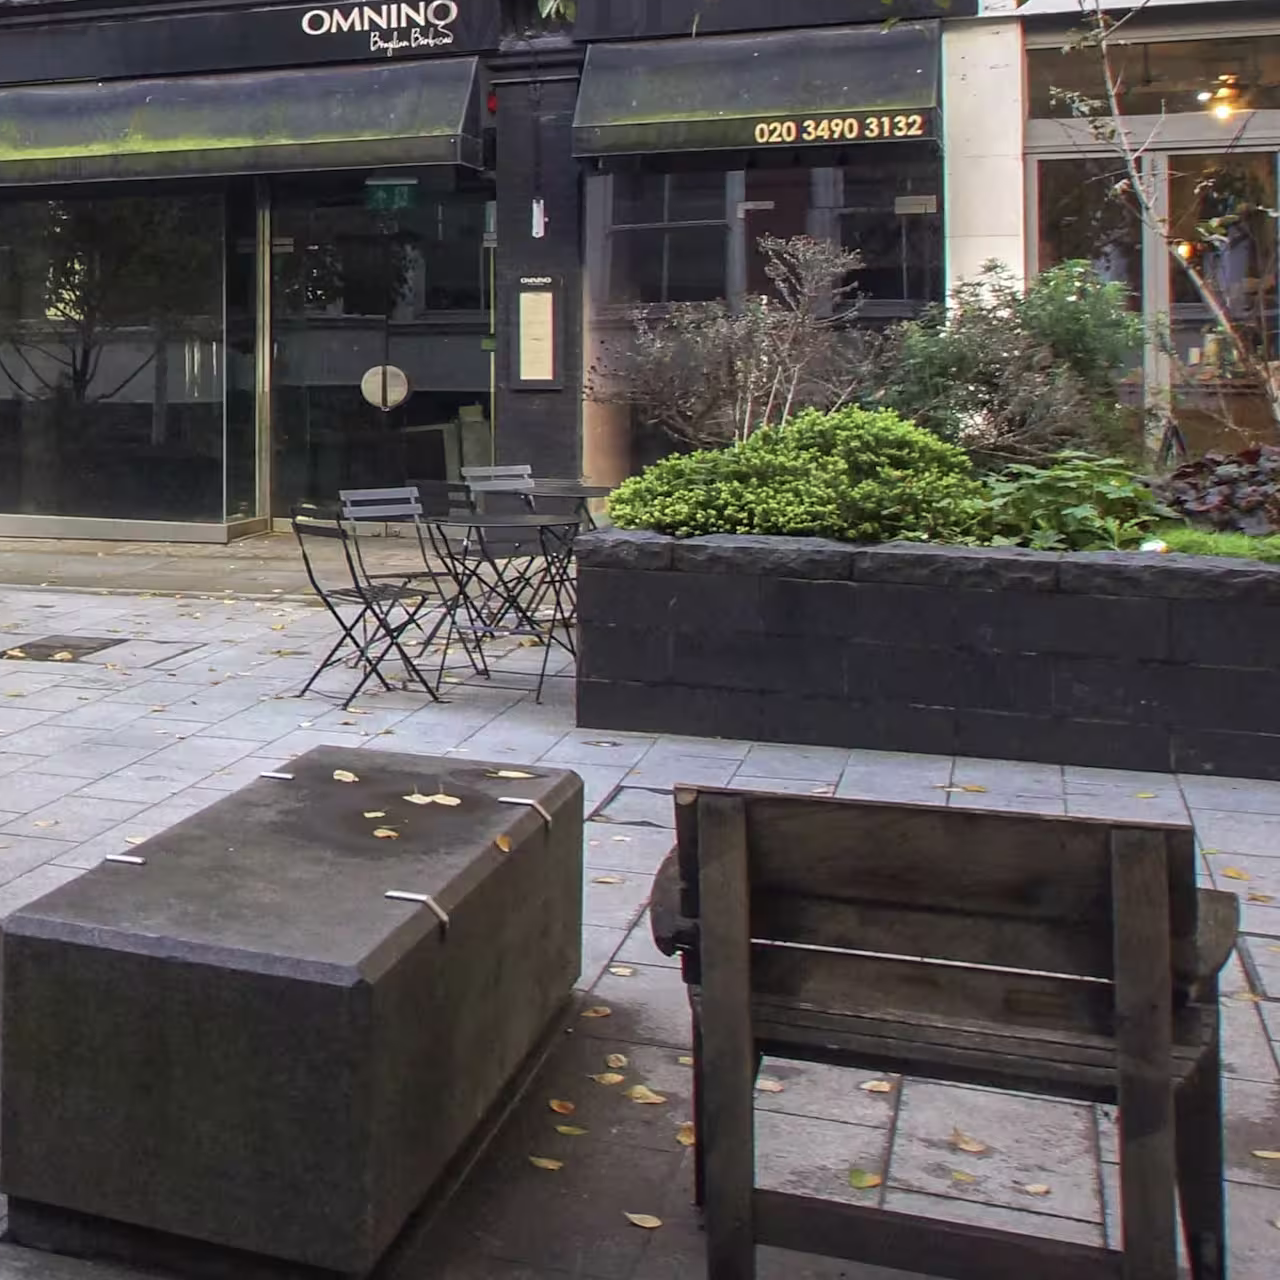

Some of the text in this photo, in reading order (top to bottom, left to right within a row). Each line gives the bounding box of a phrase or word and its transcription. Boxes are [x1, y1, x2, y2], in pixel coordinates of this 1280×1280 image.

[301, 0, 458, 37] OMNINO
[754, 114, 924, 144] 020 3490 3132
